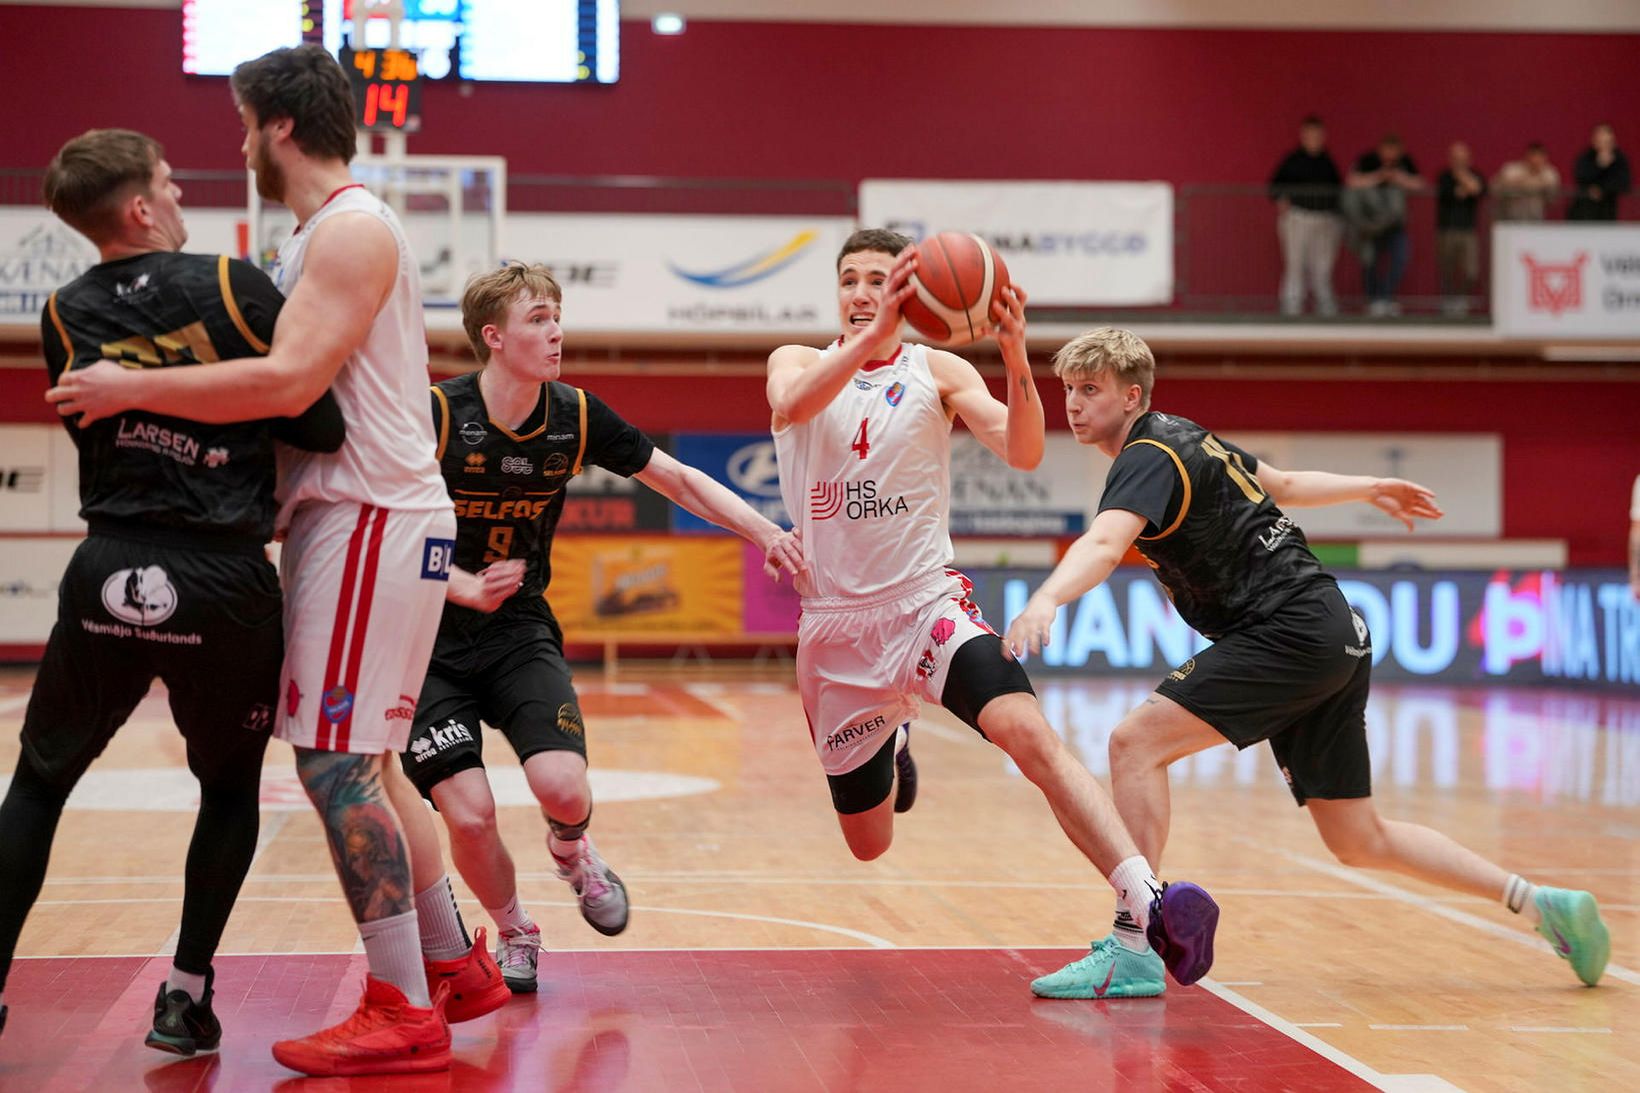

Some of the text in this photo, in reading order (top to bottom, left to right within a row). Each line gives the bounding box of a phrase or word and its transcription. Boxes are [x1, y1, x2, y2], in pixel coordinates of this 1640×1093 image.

[363, 83, 409, 127] 14
[118, 418, 200, 460] LARSEN
[851, 417, 870, 460] 4
[846, 480, 877, 500] HS
[846, 495, 909, 520] ORKA
[483, 527, 515, 563] 9
[429, 719, 474, 748] kris
